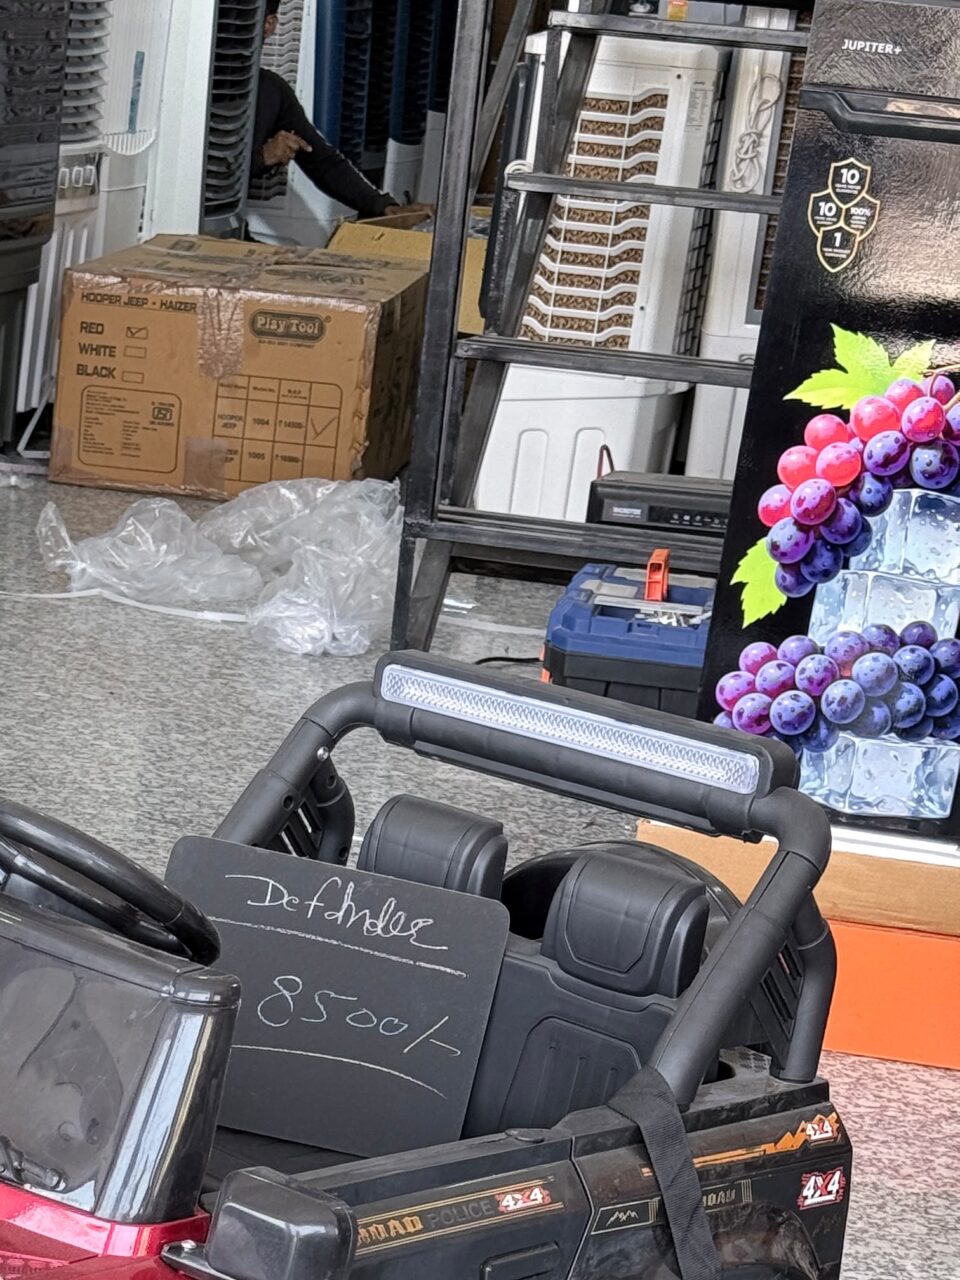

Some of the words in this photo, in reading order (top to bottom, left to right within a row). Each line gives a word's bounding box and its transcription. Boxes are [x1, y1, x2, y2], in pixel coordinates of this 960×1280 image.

[841, 39, 902, 55] JUPITER+
[840, 168, 860, 185] 10
[818, 202, 837, 217] 10
[833, 232, 842, 247] 1
[81, 292, 121, 304] HOOPER
[123, 296, 148, 307] JEEP
[160, 299, 197, 312] HAIZER
[80, 321, 104, 335] RED
[256, 316, 286, 333] Play
[290, 319, 319, 334] Tool
[78, 342, 116, 358] WHITE
[76, 363, 116, 379] BLACK
[426, 1200, 494, 1228] POLICE
